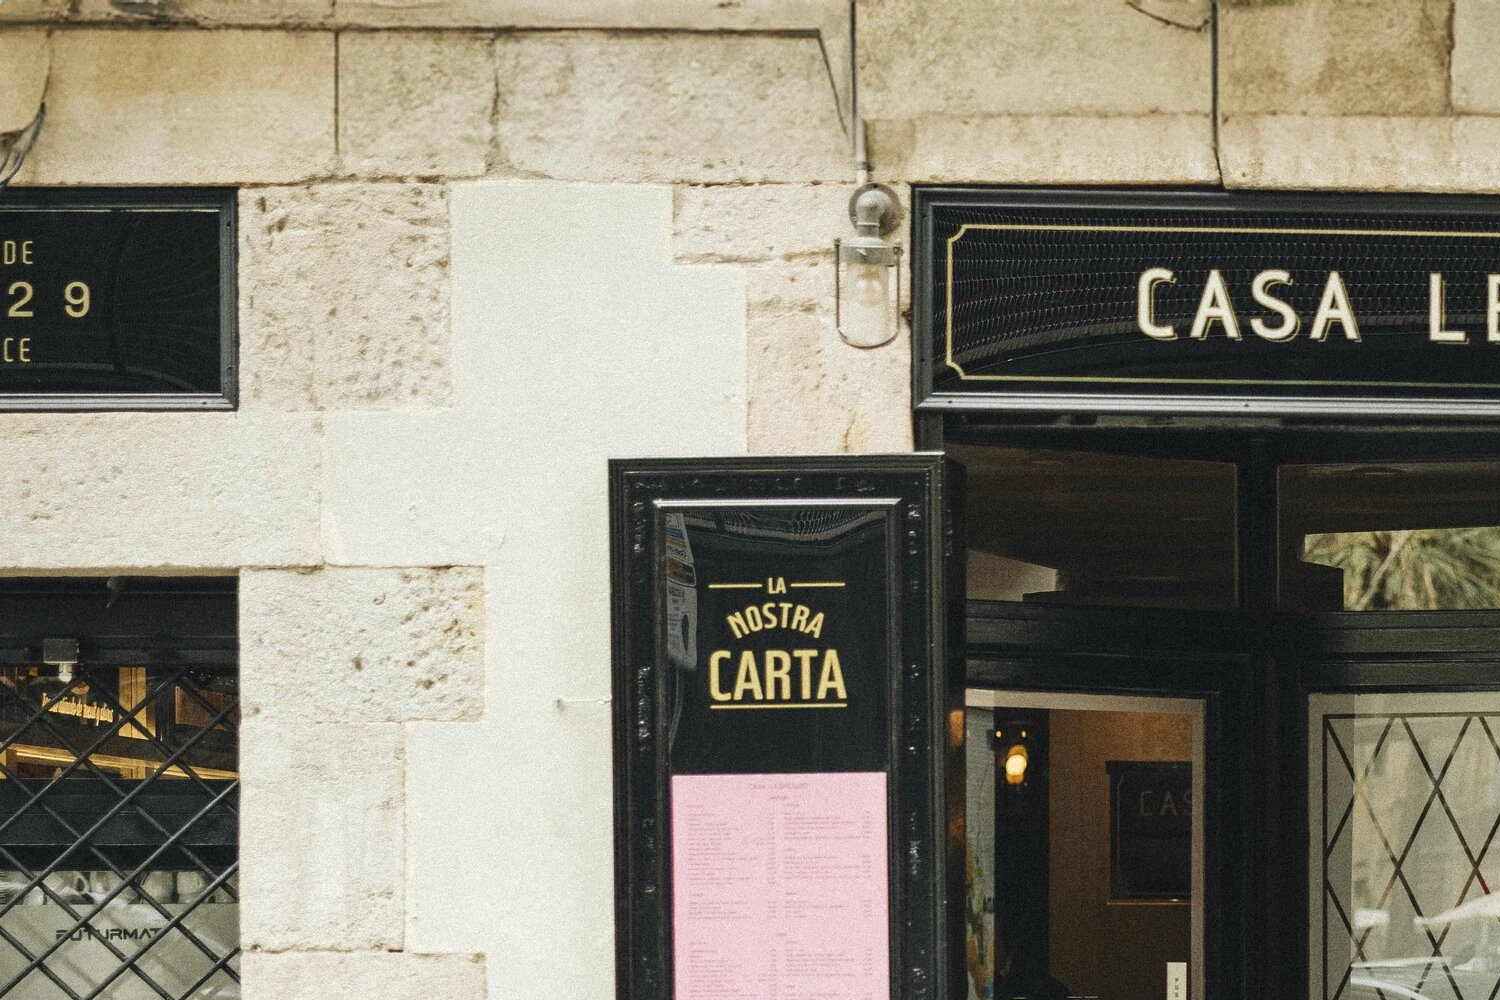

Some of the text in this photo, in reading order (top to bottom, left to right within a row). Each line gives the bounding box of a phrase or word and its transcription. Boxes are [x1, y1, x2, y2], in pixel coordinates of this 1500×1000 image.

[3, 240, 34, 265] DE
[1136, 266, 1362, 342] CASA
[3, 337, 32, 362] CE
[767, 577, 787, 594] LA
[726, 602, 825, 639] NOSTRA
[709, 649, 847, 702] CARTA
